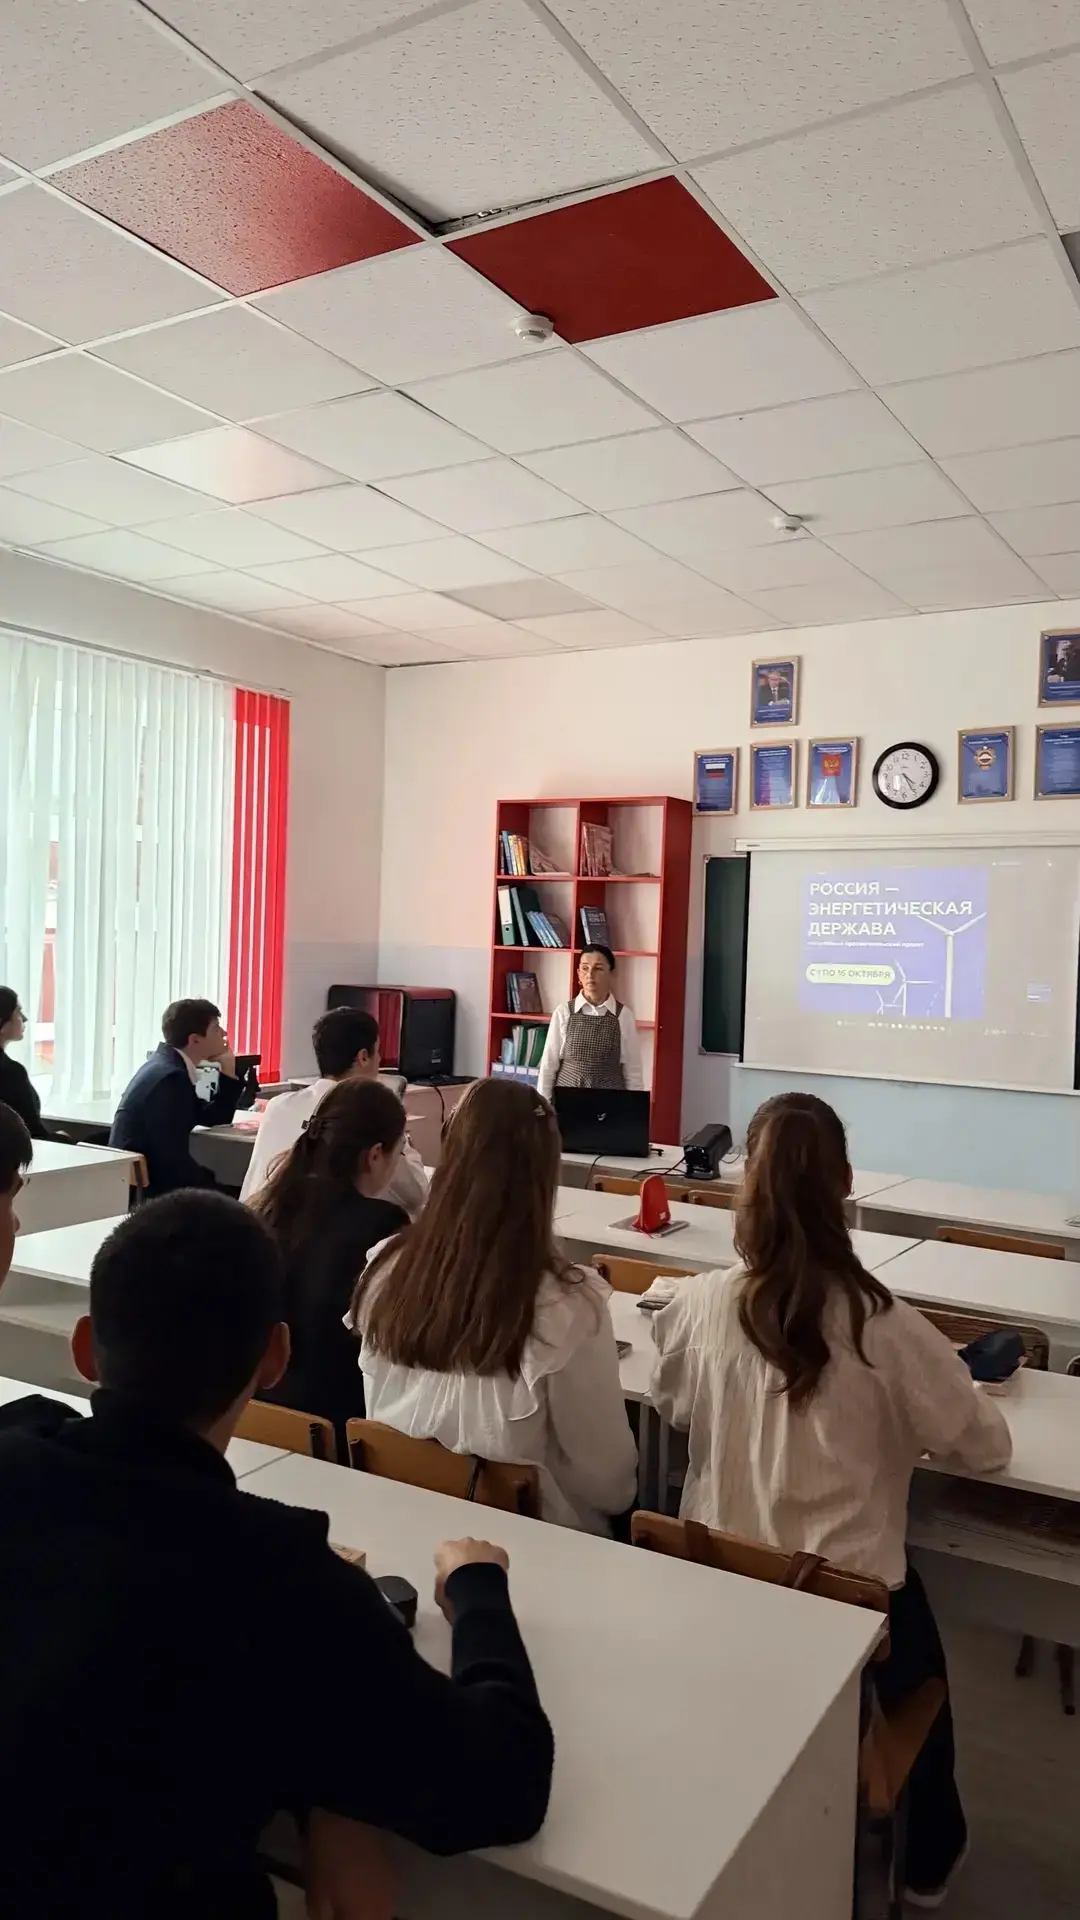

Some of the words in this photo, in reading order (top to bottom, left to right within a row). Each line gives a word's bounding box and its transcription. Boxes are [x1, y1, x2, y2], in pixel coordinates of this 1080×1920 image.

[901, 752, 910, 760] 12
[809, 882, 880, 896] РОССИЯ
[808, 900, 973, 916] ЭНЕРГЕТИЧЕСКАЯ
[807, 922, 897, 938] ДЕРЖАВА
[822, 968, 836, 977] ПО
[848, 970, 891, 979] ОКТЯБРЯ
